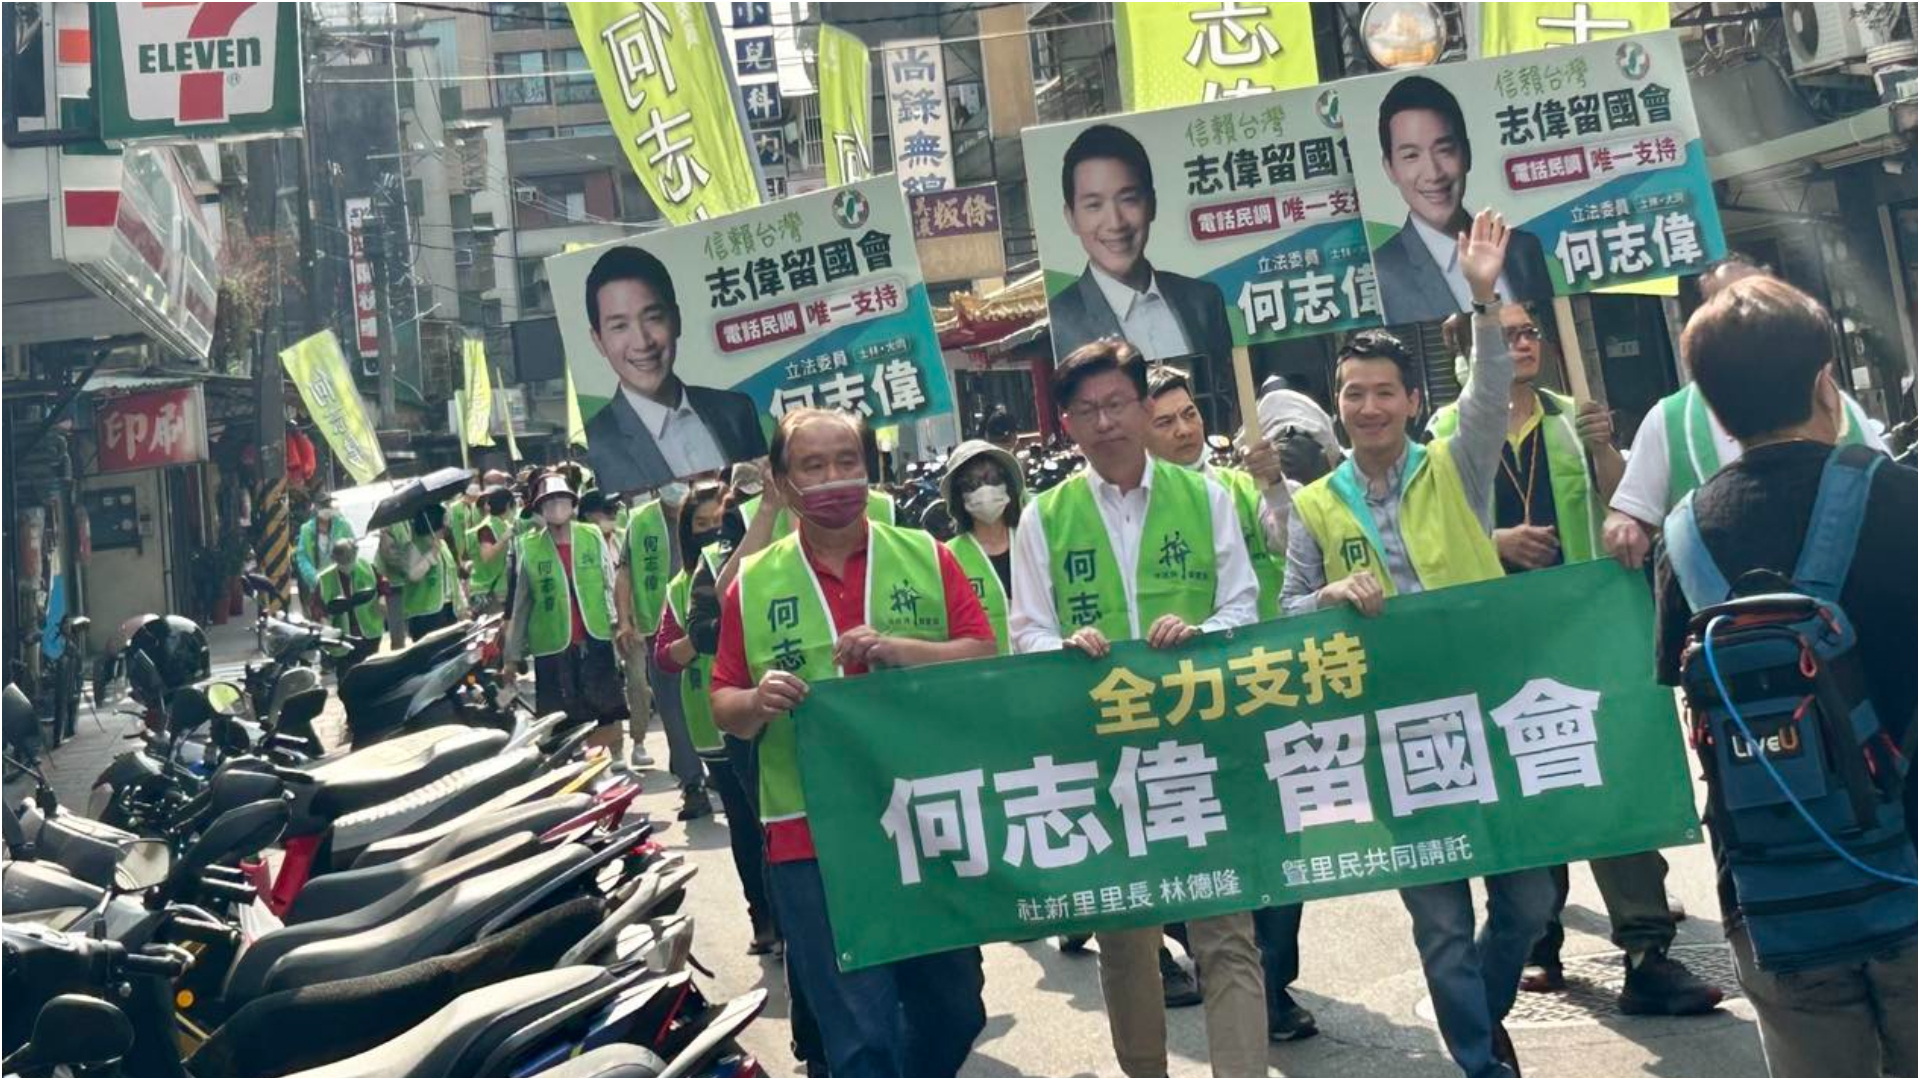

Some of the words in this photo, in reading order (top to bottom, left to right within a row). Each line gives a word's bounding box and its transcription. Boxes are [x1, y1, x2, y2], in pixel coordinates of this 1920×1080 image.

[1184, 2, 1282, 102] 志
[1185, 106, 1286, 148] 信賴台灣
[1496, 82, 1672, 145] 志偉留國會
[1184, 136, 1353, 195] 志偉留國
[1592, 138, 1677, 173] 唯一支持
[704, 211, 804, 260] 信賴台灣
[1197, 203, 1272, 234] 電話民調
[1555, 212, 1702, 285] 何志偉
[705, 230, 893, 308] 志偉留國會
[1237, 263, 1382, 335] 何志偉
[723, 310, 798, 345] 電話民調
[806, 284, 898, 326] 唯一支持
[785, 350, 848, 379] 立法委員
[104, 400, 195, 461] 印刷
[1340, 536, 1370, 571] 何
[767, 596, 806, 672] 何志
[1090, 632, 1369, 736] 全力支持
[881, 745, 1227, 886] 何志偉
[1263, 677, 1603, 834] 留國會
[1017, 881, 1153, 922] 社新里里長
[1159, 869, 1242, 904] 林德隆
[1282, 835, 1473, 887] 暨里民共同請託
